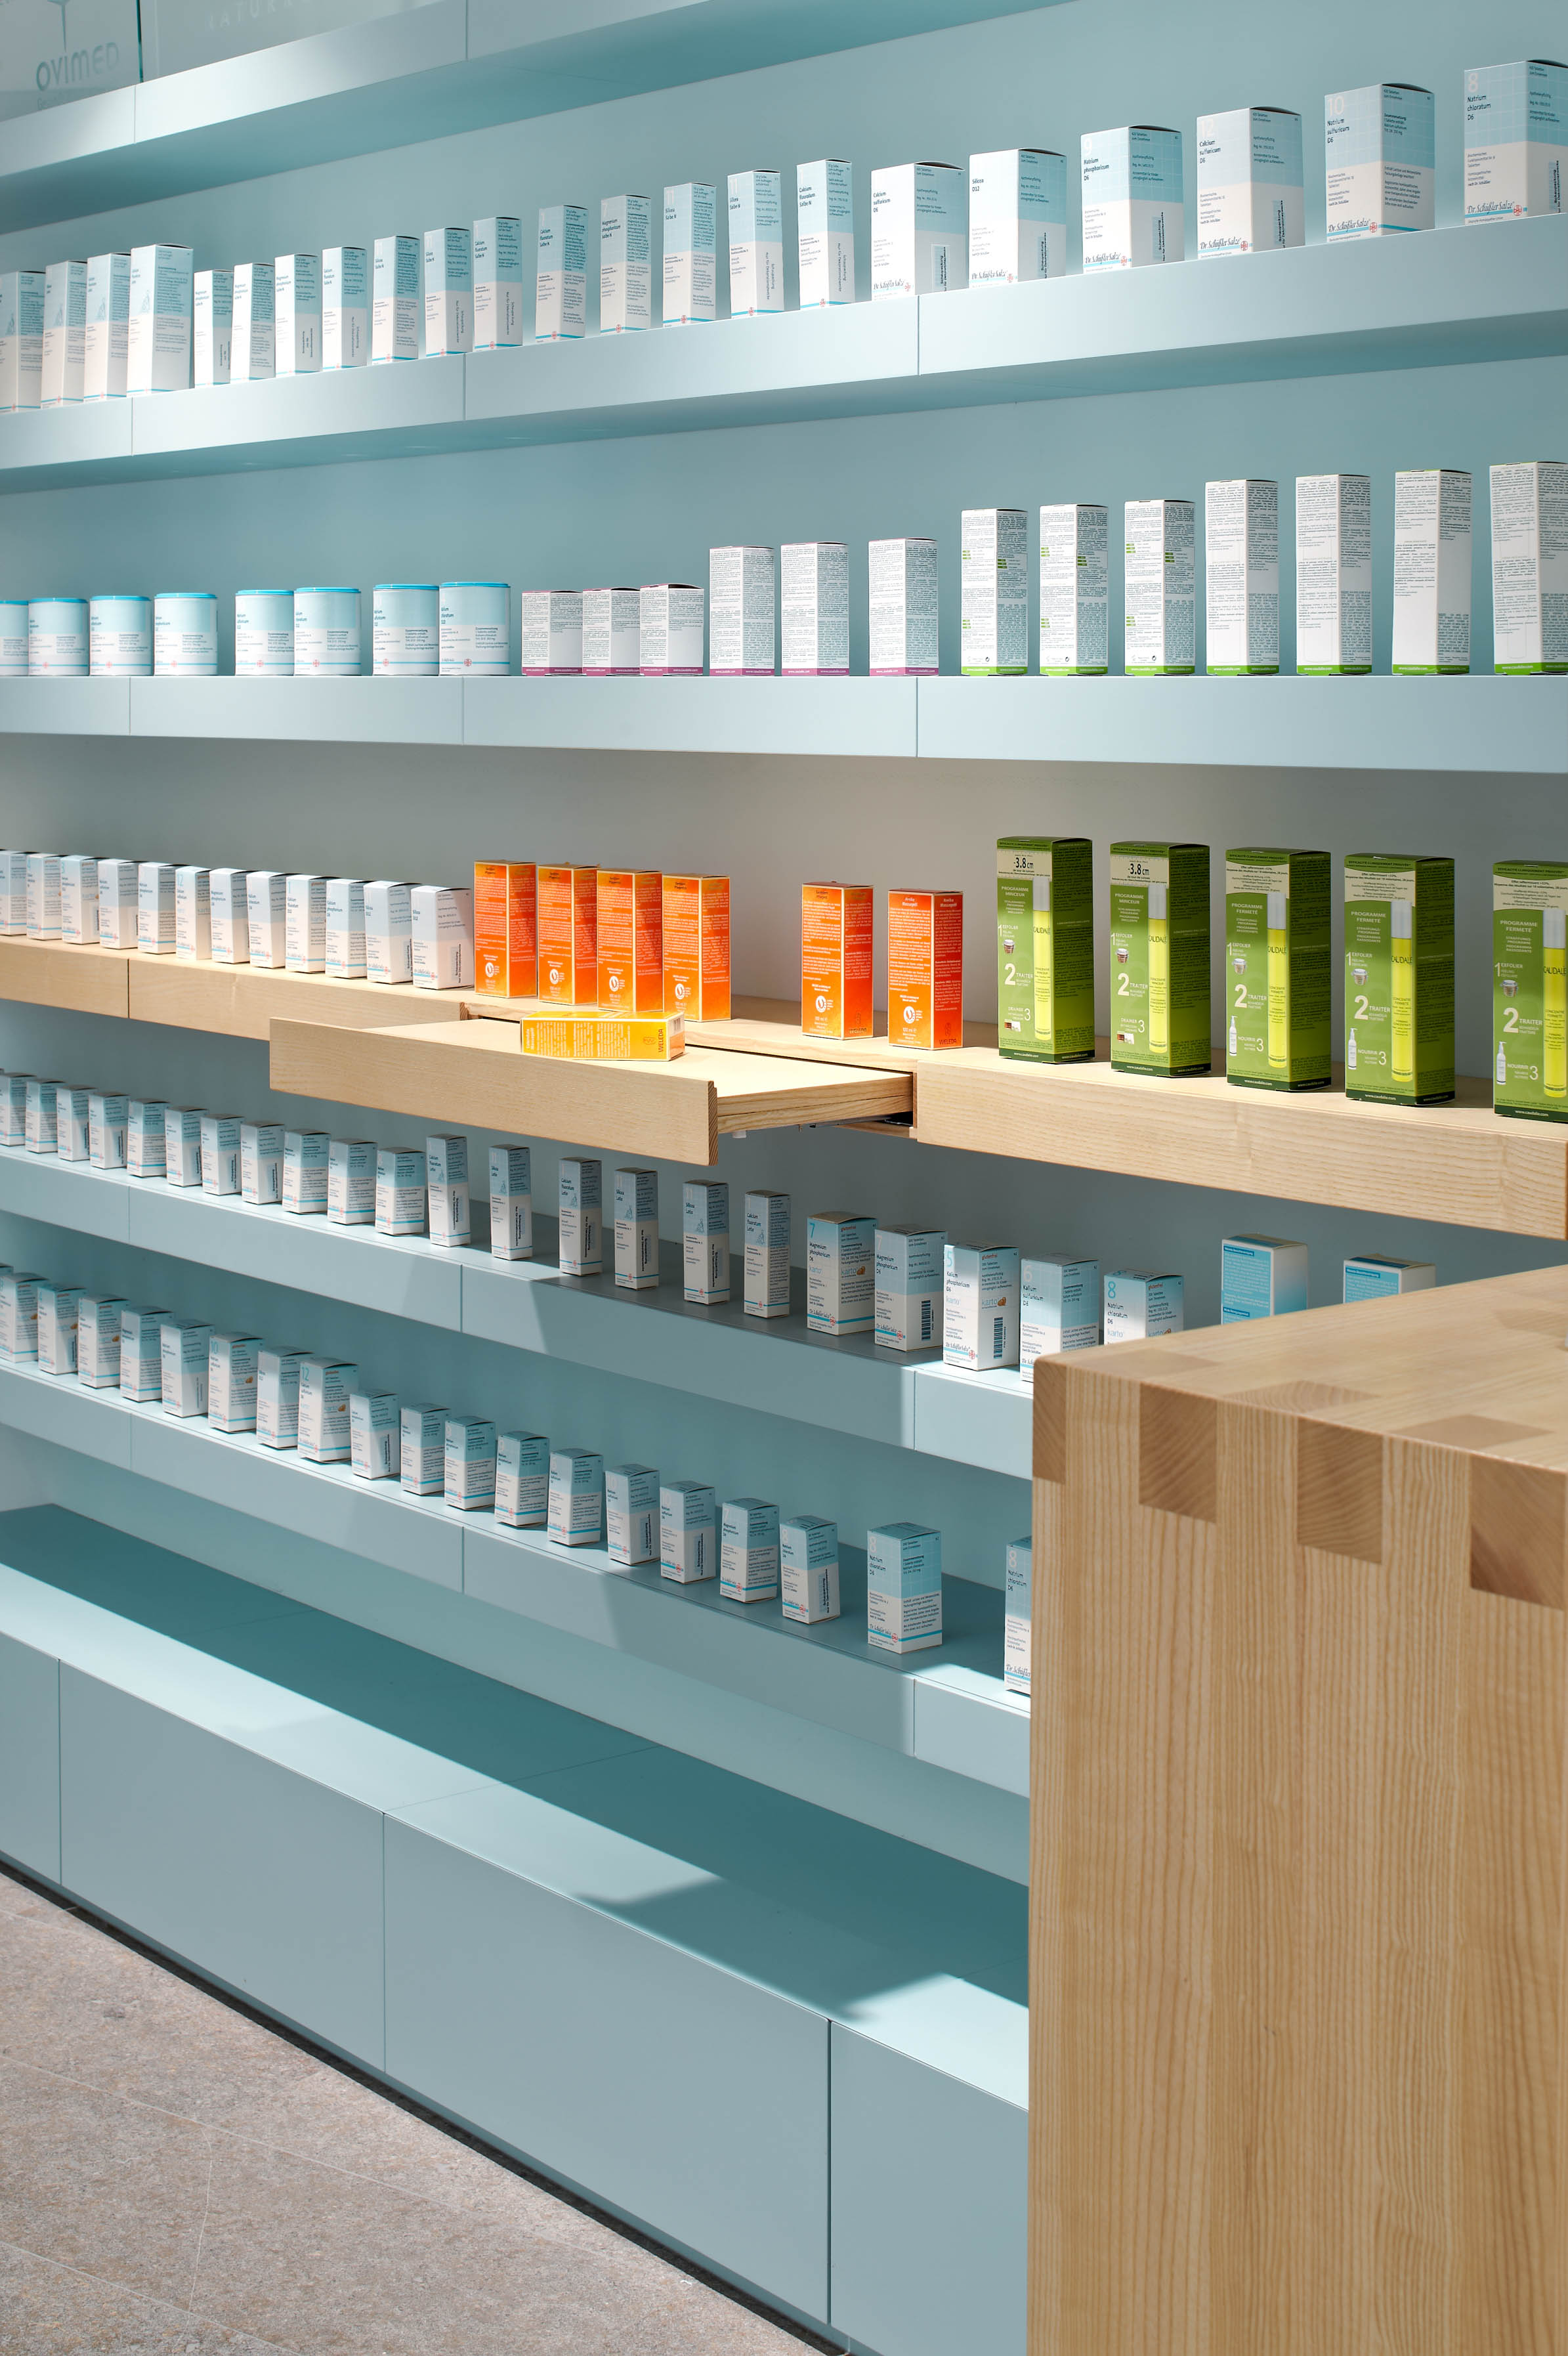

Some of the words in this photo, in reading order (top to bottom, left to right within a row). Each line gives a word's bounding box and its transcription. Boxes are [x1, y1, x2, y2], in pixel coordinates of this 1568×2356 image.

[36, 42, 119, 91] OVIMED
[1468, 72, 1479, 93] 8
[1328, 96, 1344, 116] 10
[1468, 103, 1491, 112] chloratum
[1327, 118, 1345, 127] Natrium
[1084, 164, 1109, 174] phosphoricum
[1467, 205, 1476, 213] Dr.
[1498, 200, 1513, 210] Salze
[998, 924, 1002, 937] 1
[1111, 933, 1116, 946] 1
[1227, 942, 1233, 956] 1
[1346, 952, 1351, 966] 1
[1005, 963, 1016, 985] 2
[1494, 962, 1500, 977] 1
[1117, 973, 1130, 996] 2
[1234, 984, 1248, 1008] 2
[1024, 1008, 1030, 1021] 3
[1354, 995, 1368, 1020] 2
[1138, 1019, 1145, 1033] 3
[1502, 1007, 1519, 1034] 2
[1256, 1038, 1264, 1052] 3
[1378, 1051, 1387, 1065] 3
[1529, 1065, 1538, 1081] 3
[810, 1223, 815, 1238] 7
[809, 1241, 826, 1251] Magnesium
[809, 1249, 831, 1258] phosphoricum
[876, 1253, 895, 1262] Magnesium
[946, 1251, 952, 1267] 5
[841, 1267, 857, 1276] karto
[876, 1261, 898, 1271] phosphoricum
[1023, 1266, 1033, 1282] 6
[1107, 1281, 1116, 1299] 8
[1023, 1293, 1044, 1302] sulfuricum
[1107, 1310, 1128, 1319] chloratum
[1107, 1328, 1124, 1339] karto
[869, 1535, 877, 1553] 8
[1009, 1550, 1017, 1568] 8
[1007, 1577, 1027, 1587] chloratum
